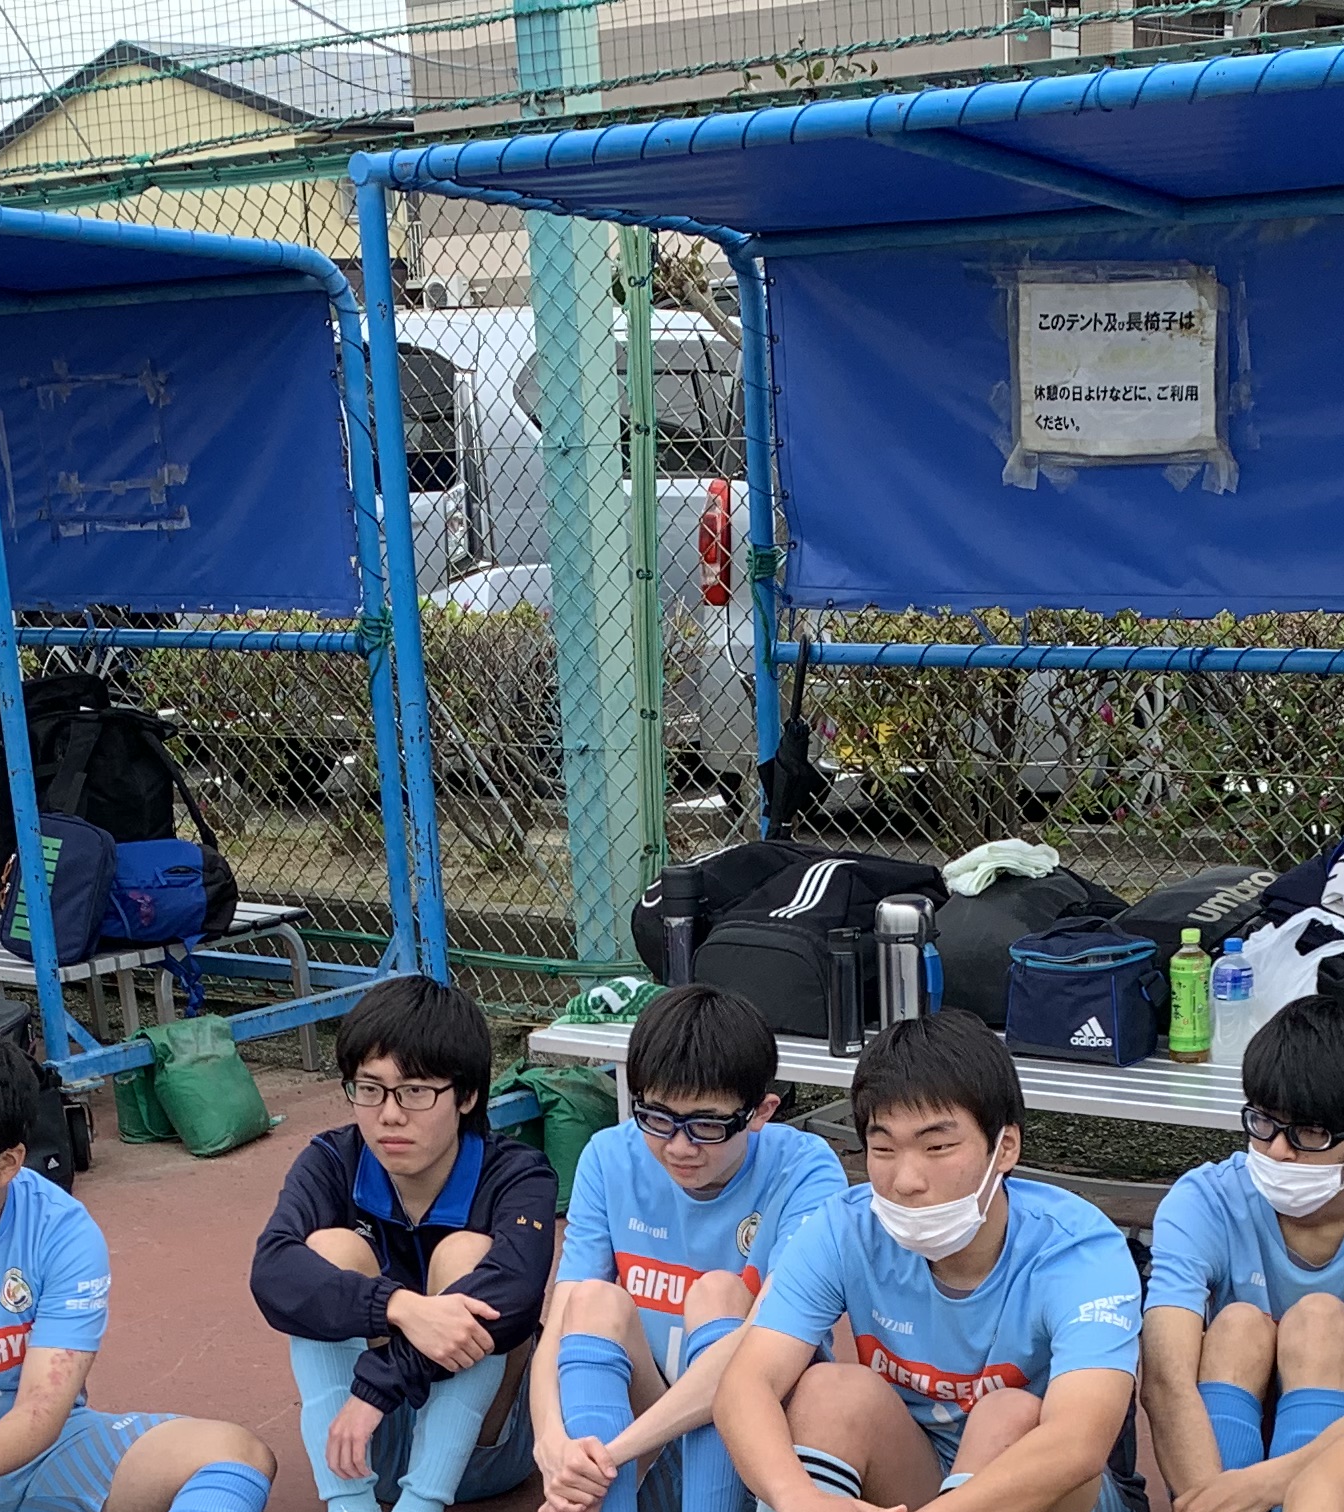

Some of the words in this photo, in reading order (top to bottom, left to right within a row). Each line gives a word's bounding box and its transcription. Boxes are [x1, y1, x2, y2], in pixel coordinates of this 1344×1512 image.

[1037, 310, 1196, 333] このテント及び長椅子は
[1033, 414, 1081, 432] ください。
[1186, 870, 1278, 923] umbro
[1069, 1035, 1113, 1048] adidas
[625, 1264, 686, 1306] GIFU
[870, 1347, 931, 1396] GIFU
